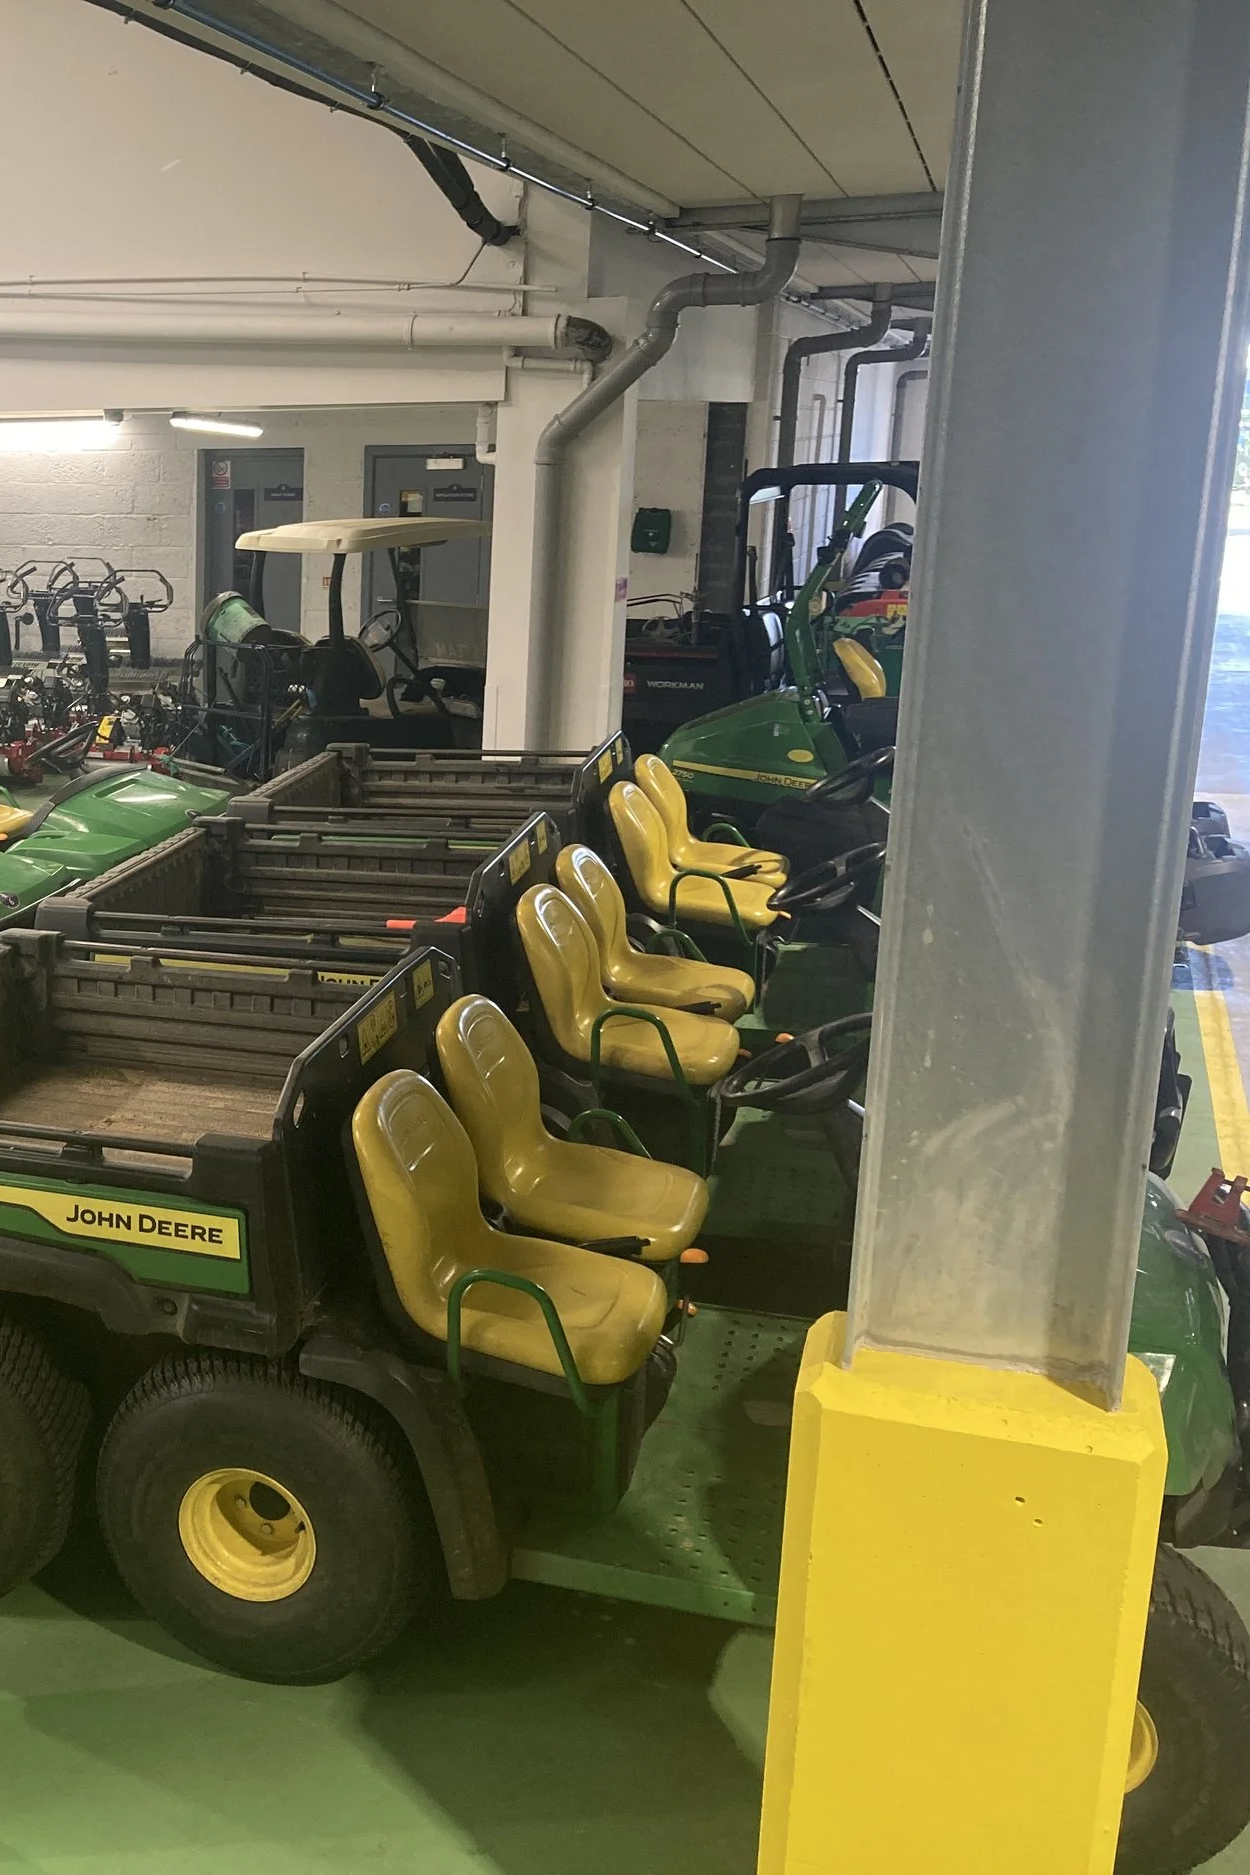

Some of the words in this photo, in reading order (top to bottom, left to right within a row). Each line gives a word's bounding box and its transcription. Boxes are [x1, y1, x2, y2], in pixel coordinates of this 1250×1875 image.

[646, 680, 704, 690] WORKMAN
[754, 773, 782, 785] JOHN
[783, 777, 811, 788] DEER
[66, 1204, 132, 1231] JOHN
[138, 1213, 223, 1245] DEERE
